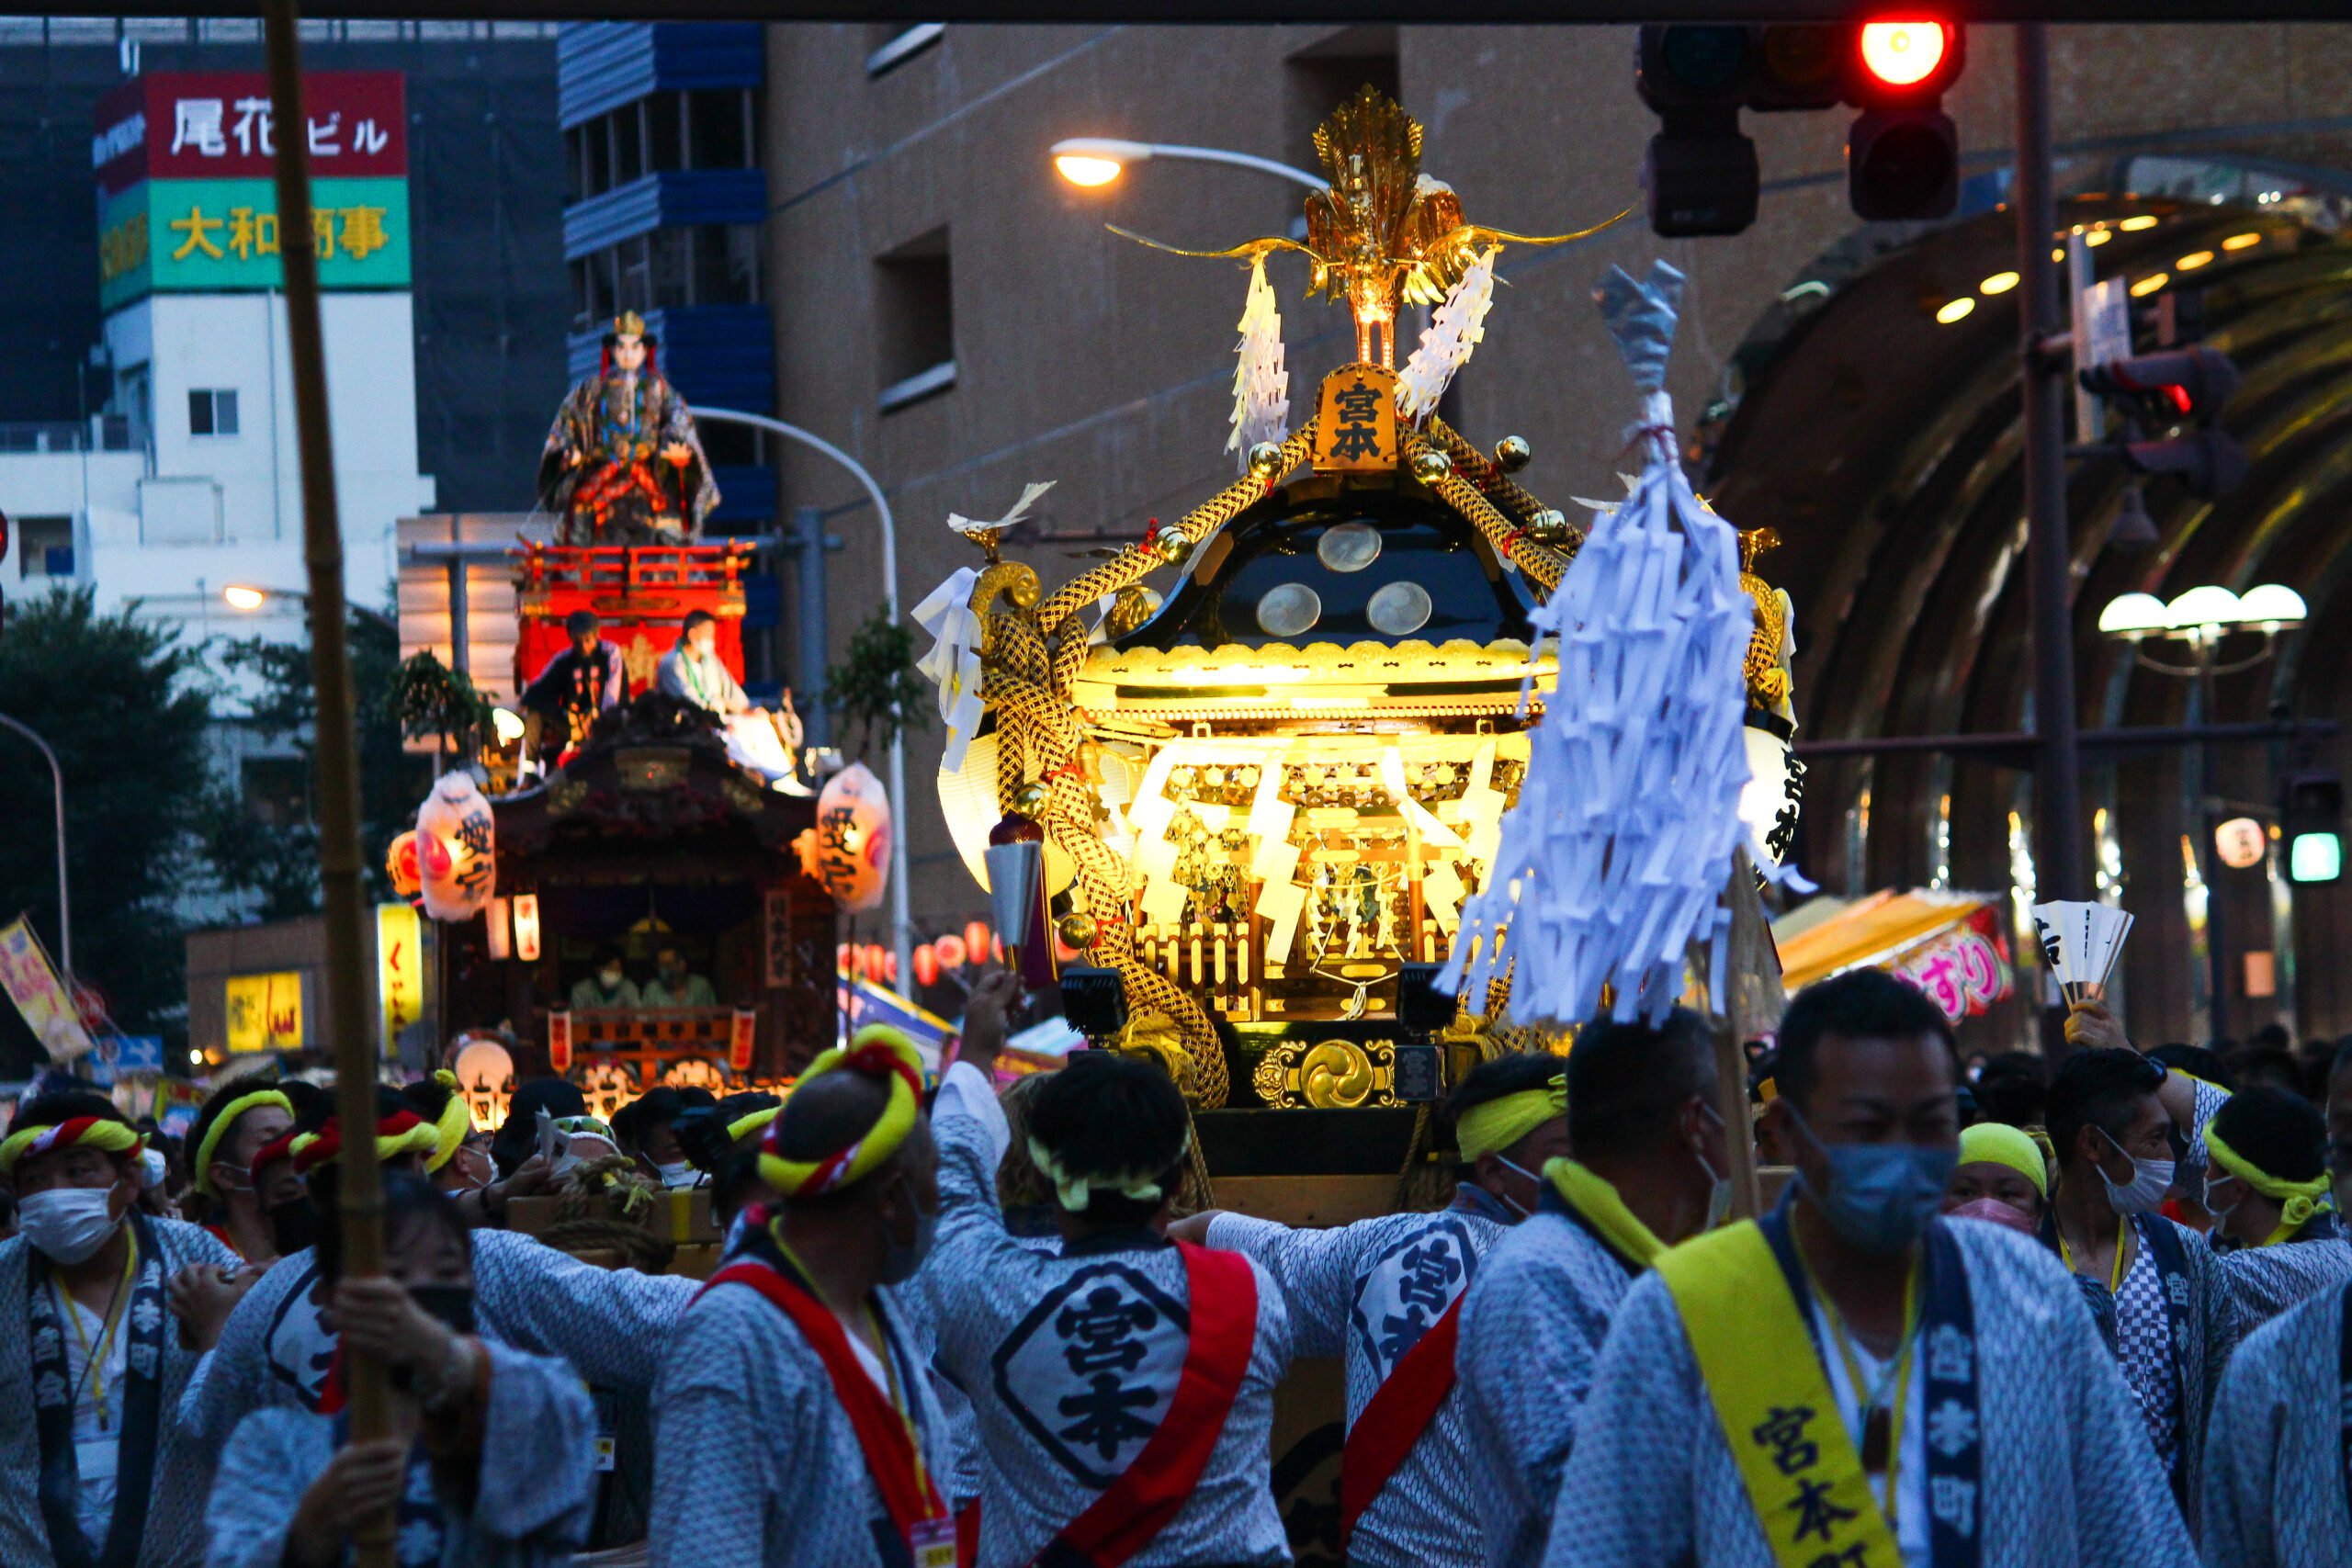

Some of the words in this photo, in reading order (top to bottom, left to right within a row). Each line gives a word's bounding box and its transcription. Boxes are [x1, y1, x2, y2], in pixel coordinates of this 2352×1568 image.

[171, 96, 388, 156] 尾花ビル
[1329, 382, 1384, 462] 宮本
[1754, 747, 1806, 890] 宮本
[1378, 1238, 1463, 1371] 宮本
[2165, 1271, 2190, 1382] 宮本
[1055, 1286, 1159, 1463] 宮本
[1928, 1323, 1977, 1538] 宮本町
